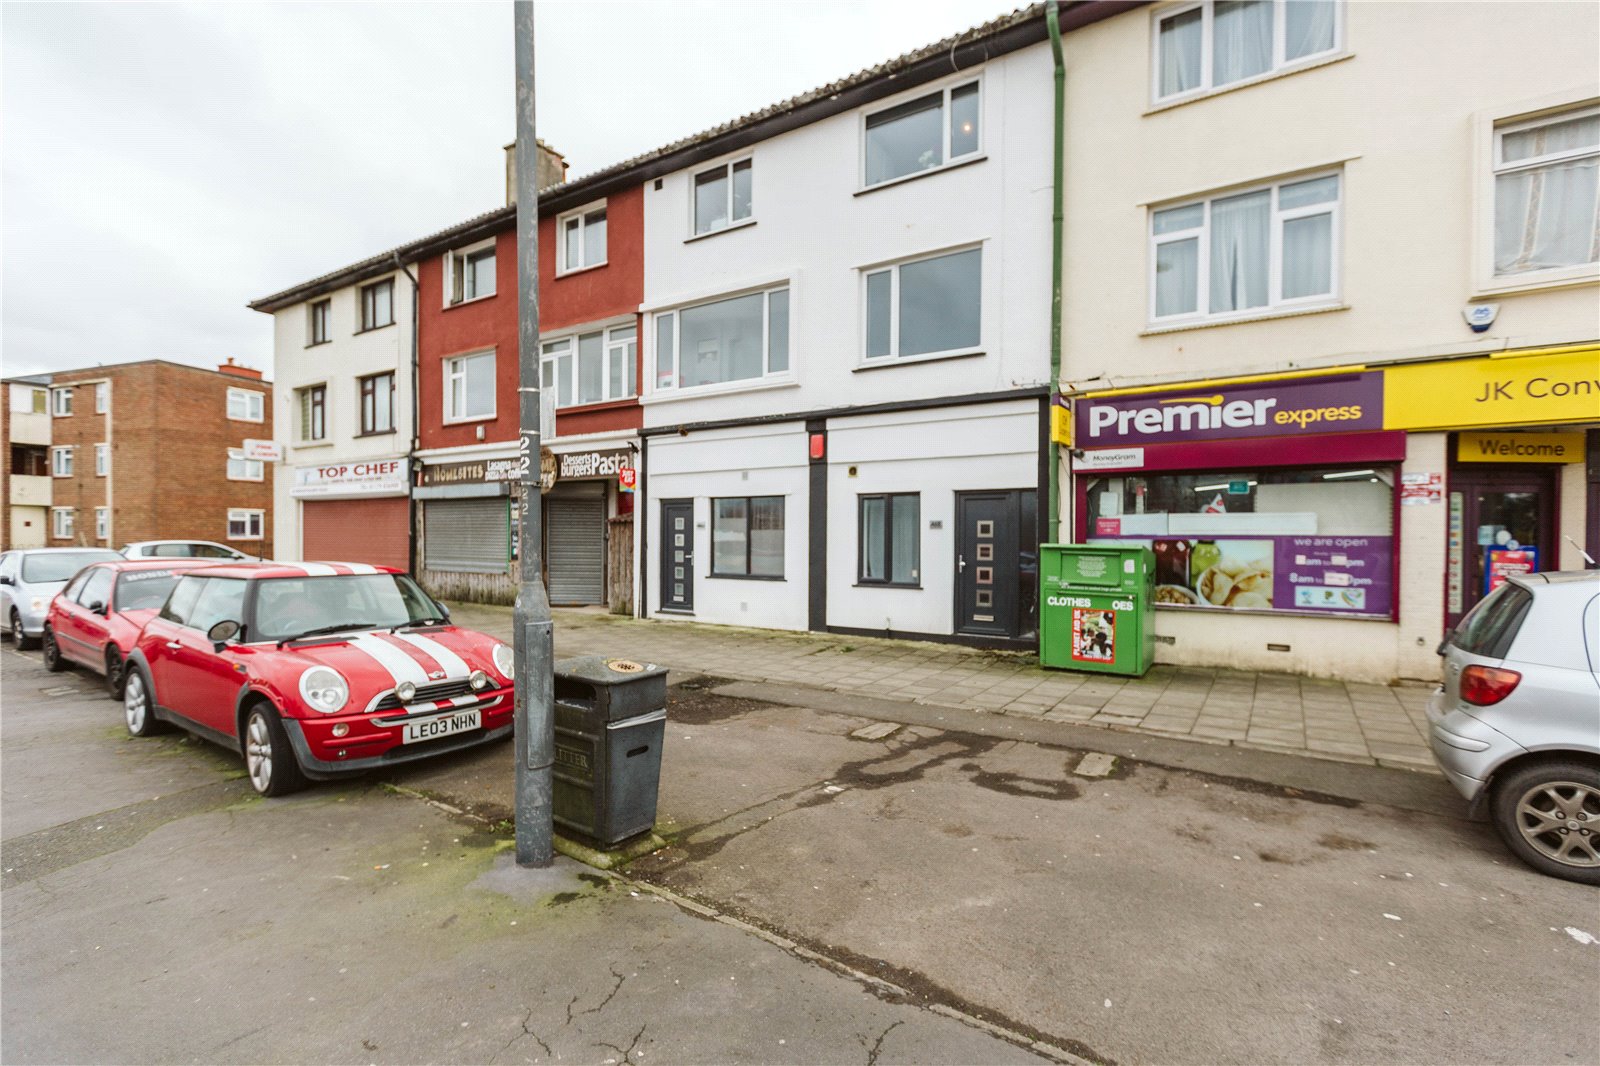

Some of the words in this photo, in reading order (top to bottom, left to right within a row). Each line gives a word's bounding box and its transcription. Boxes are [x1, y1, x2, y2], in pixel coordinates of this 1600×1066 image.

[1475, 380, 1513, 402] JK
[1089, 395, 1277, 437] Premier
[1275, 404, 1362, 428] express
[1478, 438, 1565, 457] Welcome
[564, 453, 592, 466] Desserts
[591, 452, 629, 475] Pasta
[317, 466, 347, 479] TOP
[353, 461, 399, 476] CHEF
[561, 462, 592, 477] burgers
[1294, 538, 1312, 546] we
[1313, 538, 1333, 546] are
[1335, 538, 1368, 548] open
[1047, 596, 1092, 608] CLOTHES
[1112, 600, 1134, 611] OES
[410, 720, 448, 740] LE03
[451, 713, 477, 731] NHN
